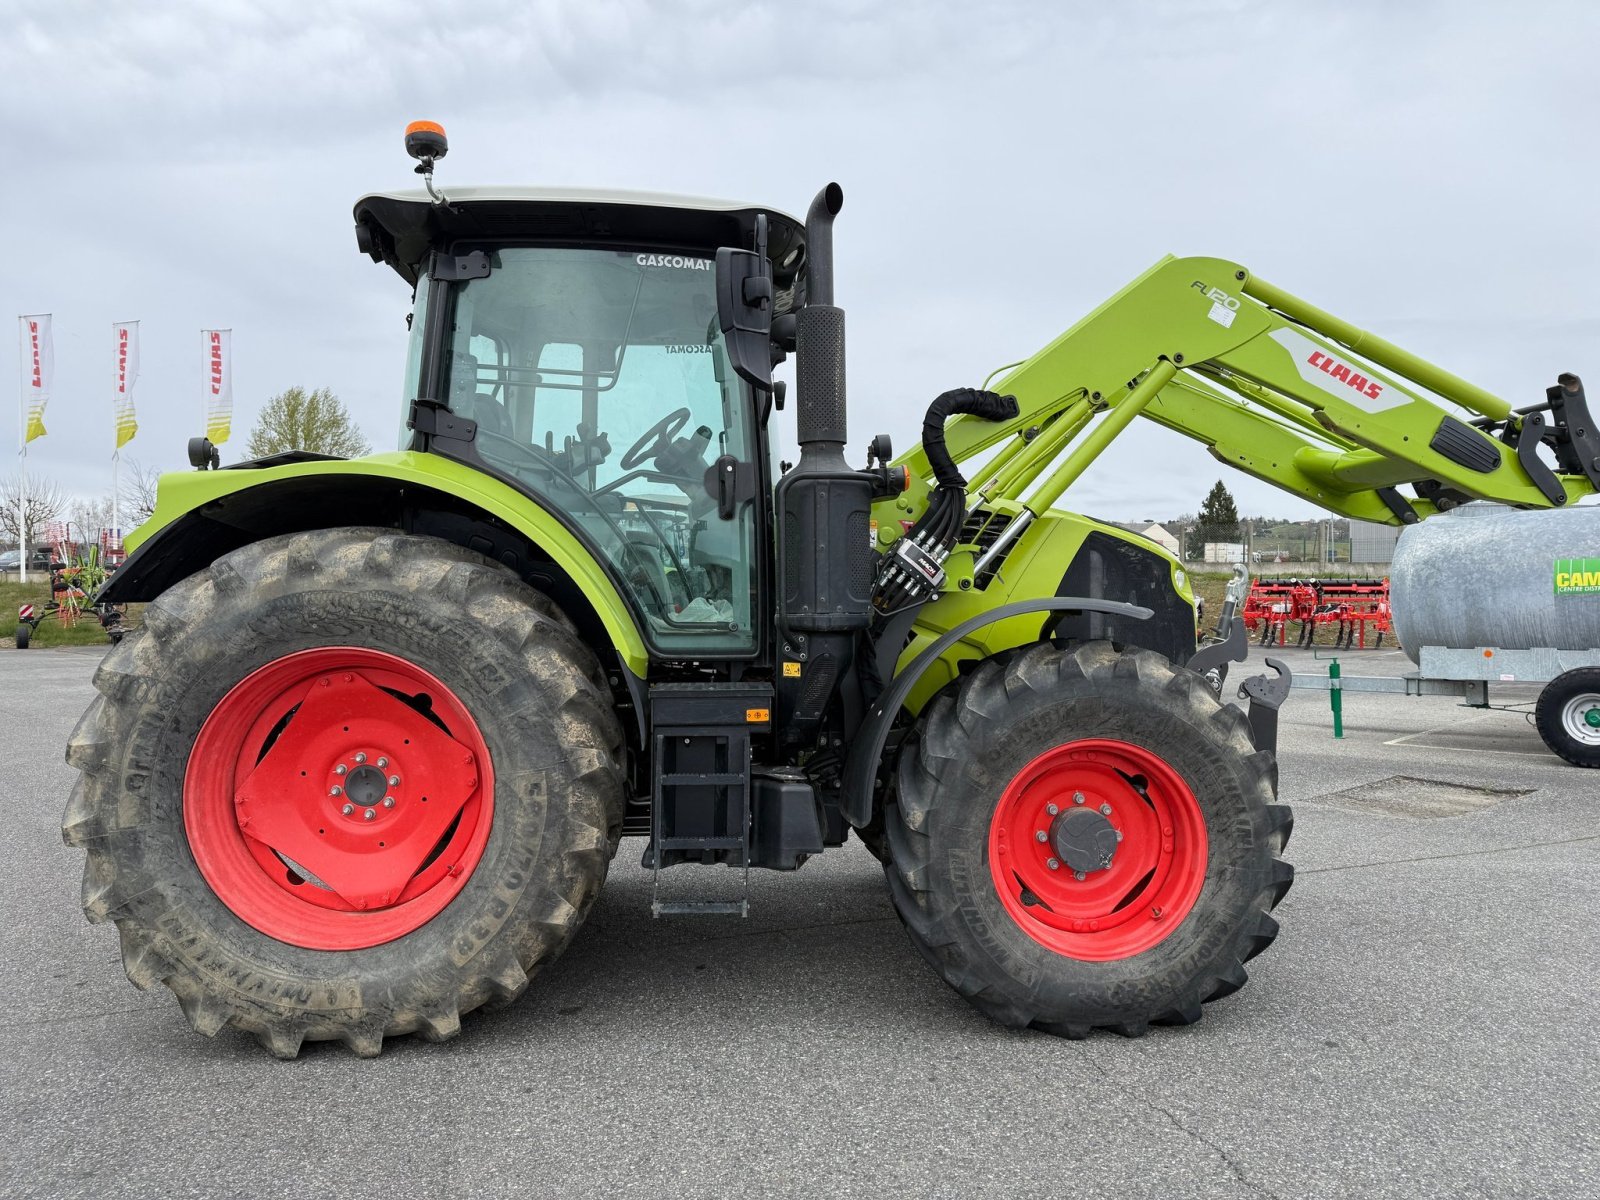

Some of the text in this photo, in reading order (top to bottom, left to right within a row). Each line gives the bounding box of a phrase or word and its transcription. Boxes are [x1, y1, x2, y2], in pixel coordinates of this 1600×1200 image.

[636, 253, 712, 271] GASCOMAT
[210, 332, 222, 395] CLAAS
[1307, 351, 1384, 400] CLAAS
